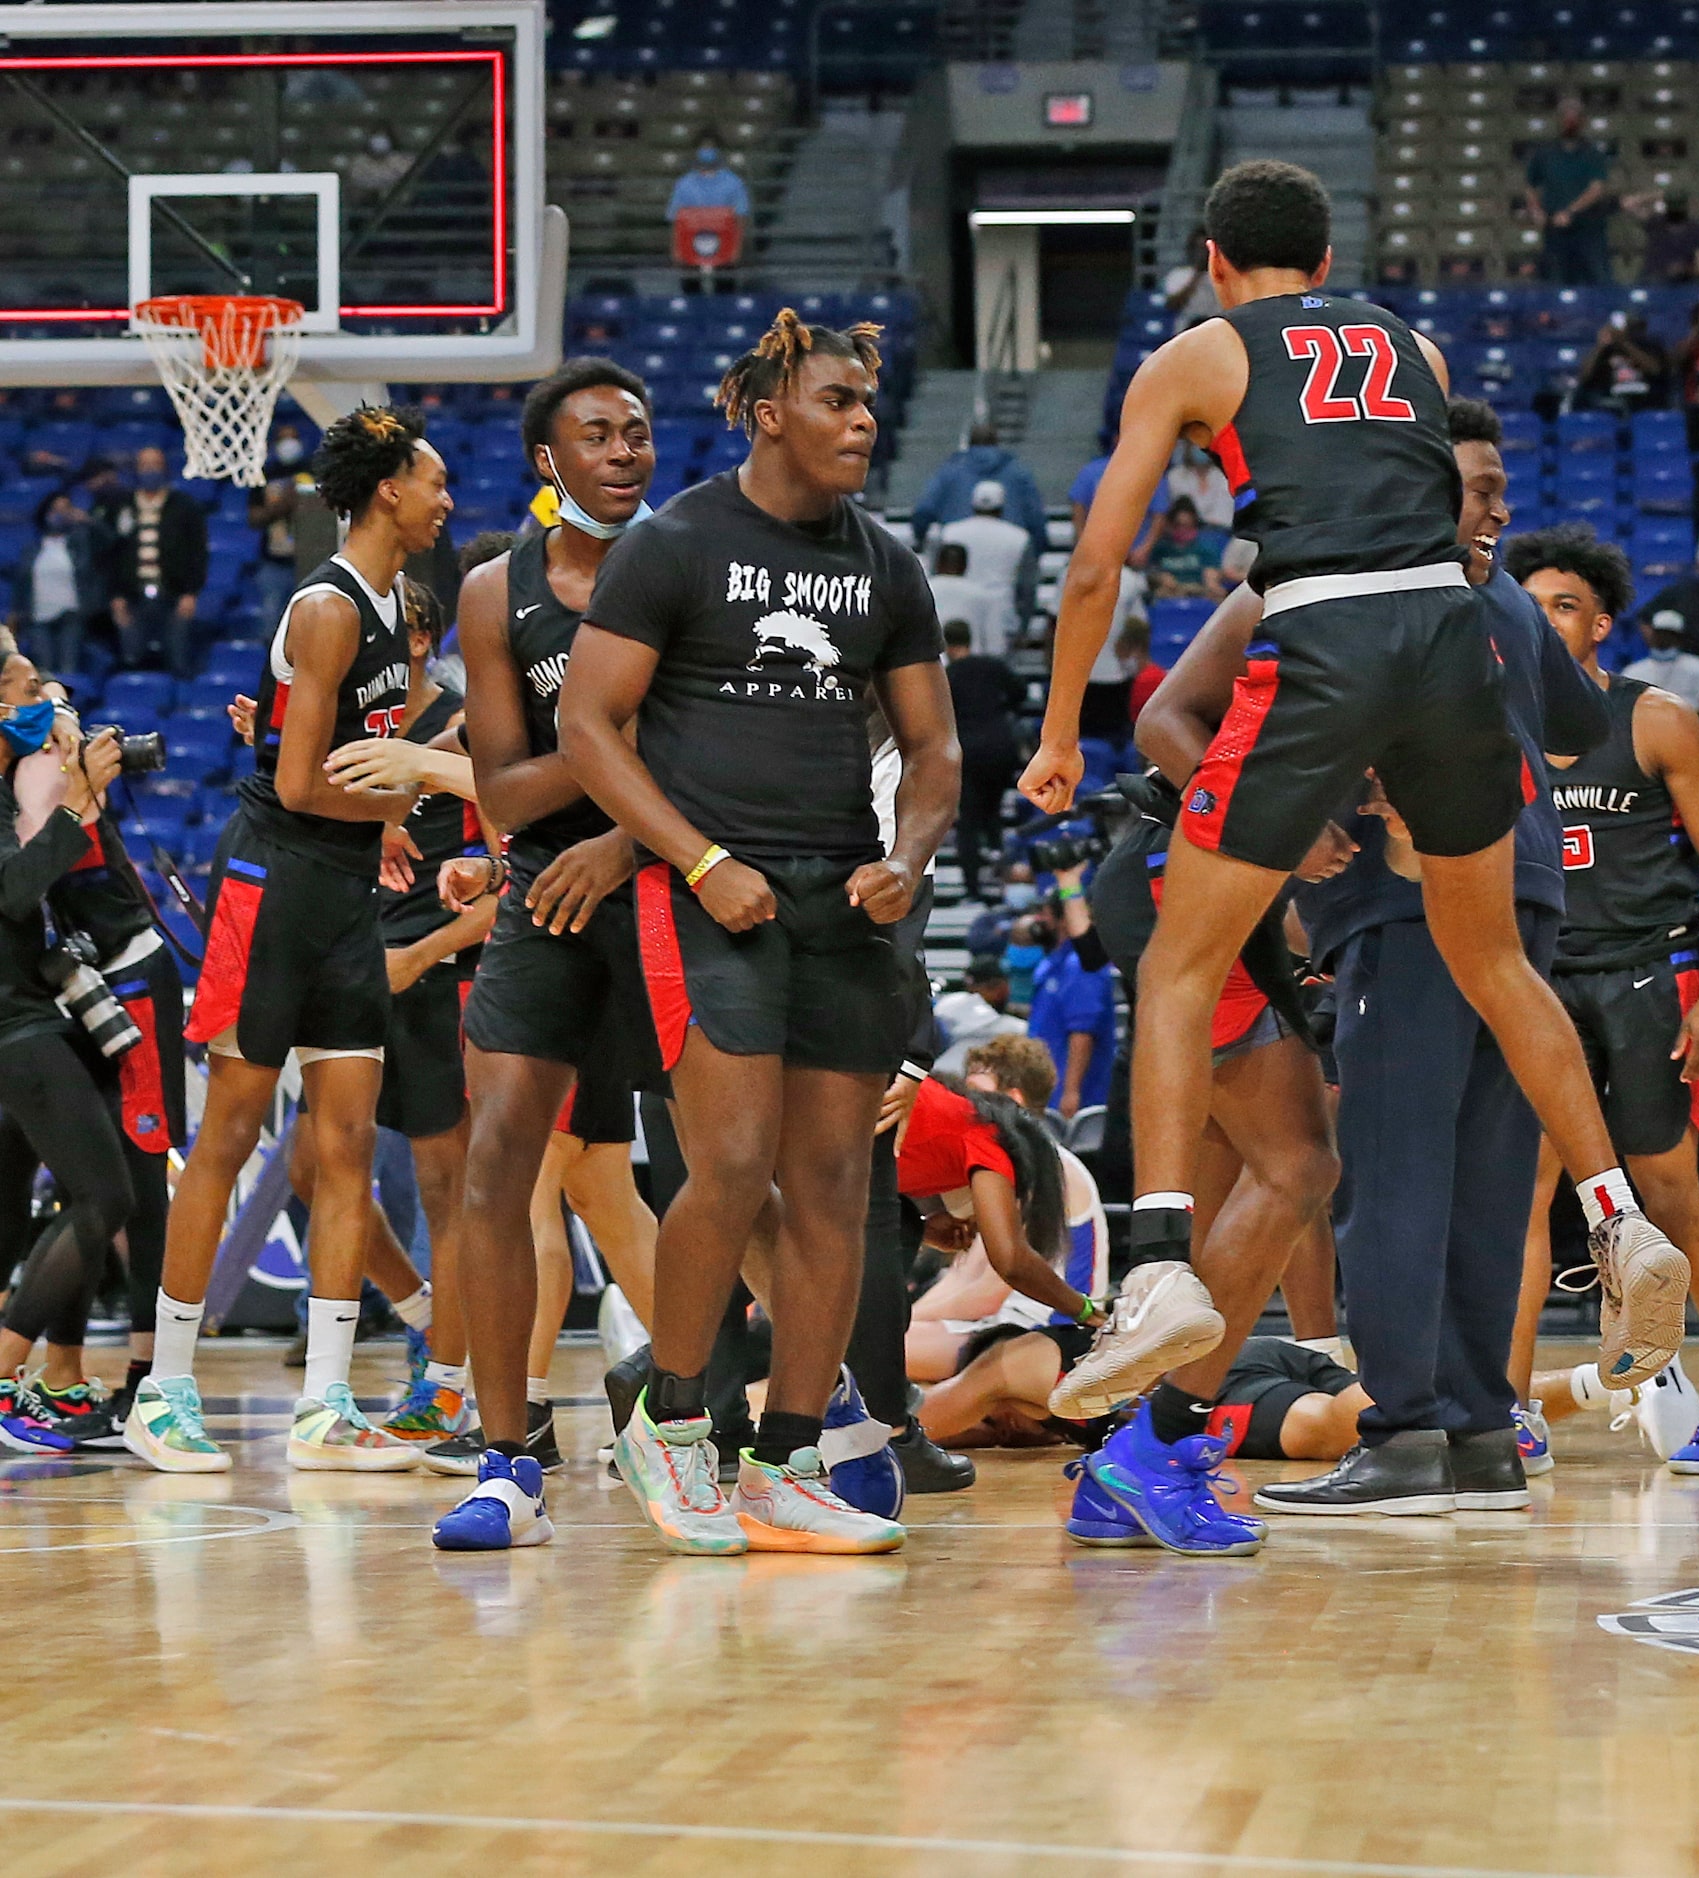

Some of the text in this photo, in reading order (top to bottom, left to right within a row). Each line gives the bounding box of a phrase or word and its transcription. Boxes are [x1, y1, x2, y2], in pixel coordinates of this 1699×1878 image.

[1281, 324, 1417, 424] 22
[726, 560, 872, 616] BIG SMOOTH
